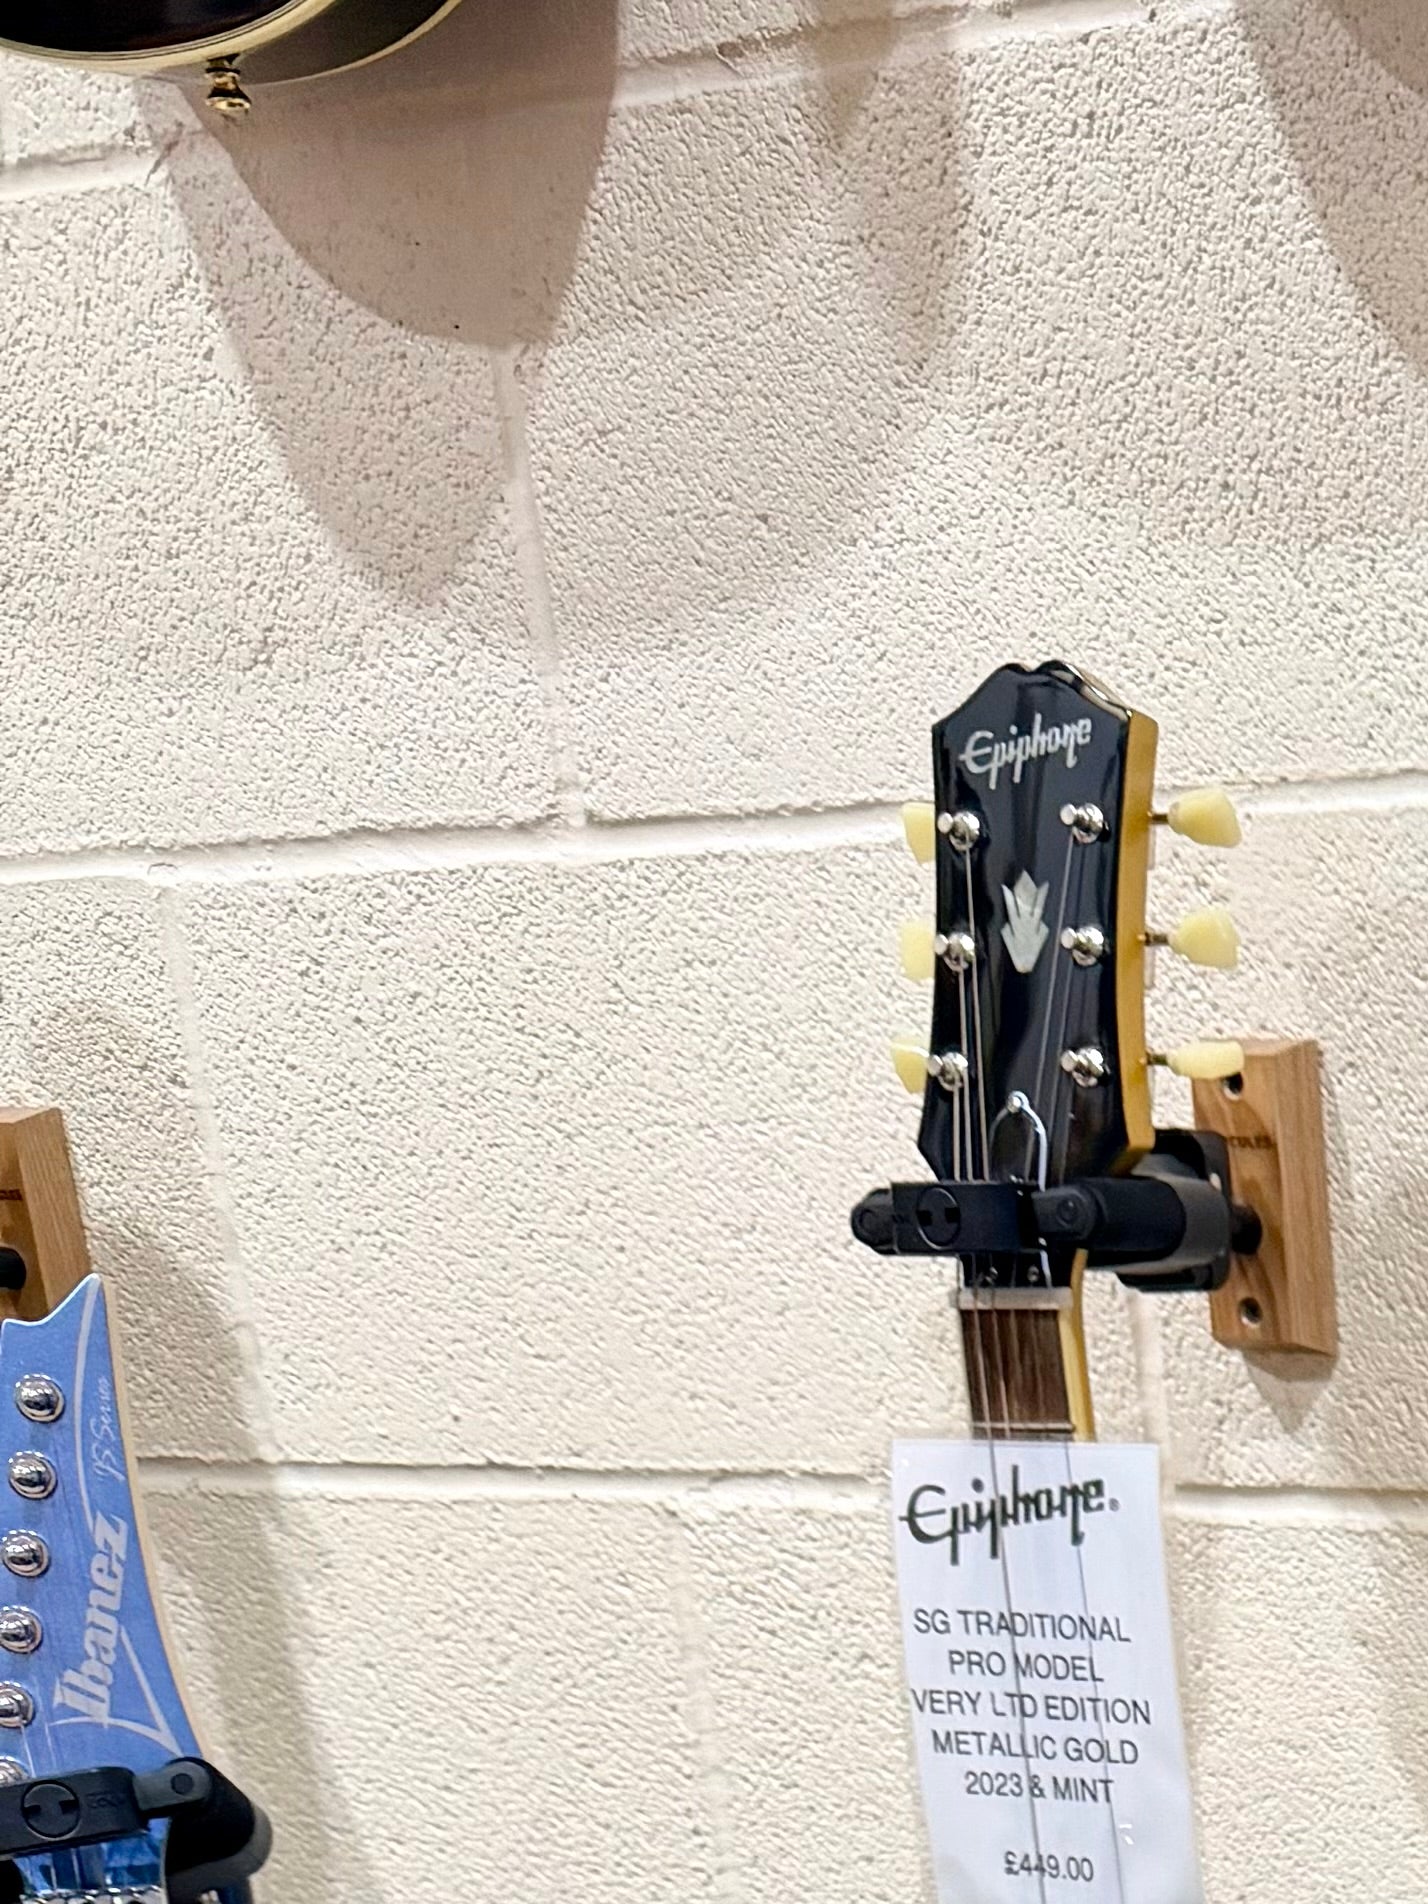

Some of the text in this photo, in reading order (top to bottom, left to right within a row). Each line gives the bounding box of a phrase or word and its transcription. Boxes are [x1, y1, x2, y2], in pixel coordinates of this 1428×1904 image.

[959, 712, 1093, 790] Epiphone
[52, 1509, 128, 1729] Ibanez
[913, 1608, 1132, 1643] SG TRADITIONAL
[948, 1650, 1104, 1682] PRO MODEL
[910, 1688, 1151, 1725] VERY LTD EDITION
[931, 1729, 1139, 1765] METALLIC GOLD
[965, 1771, 1115, 1804] 2023 & MINT
[1004, 1851, 1094, 1884] £449.00
